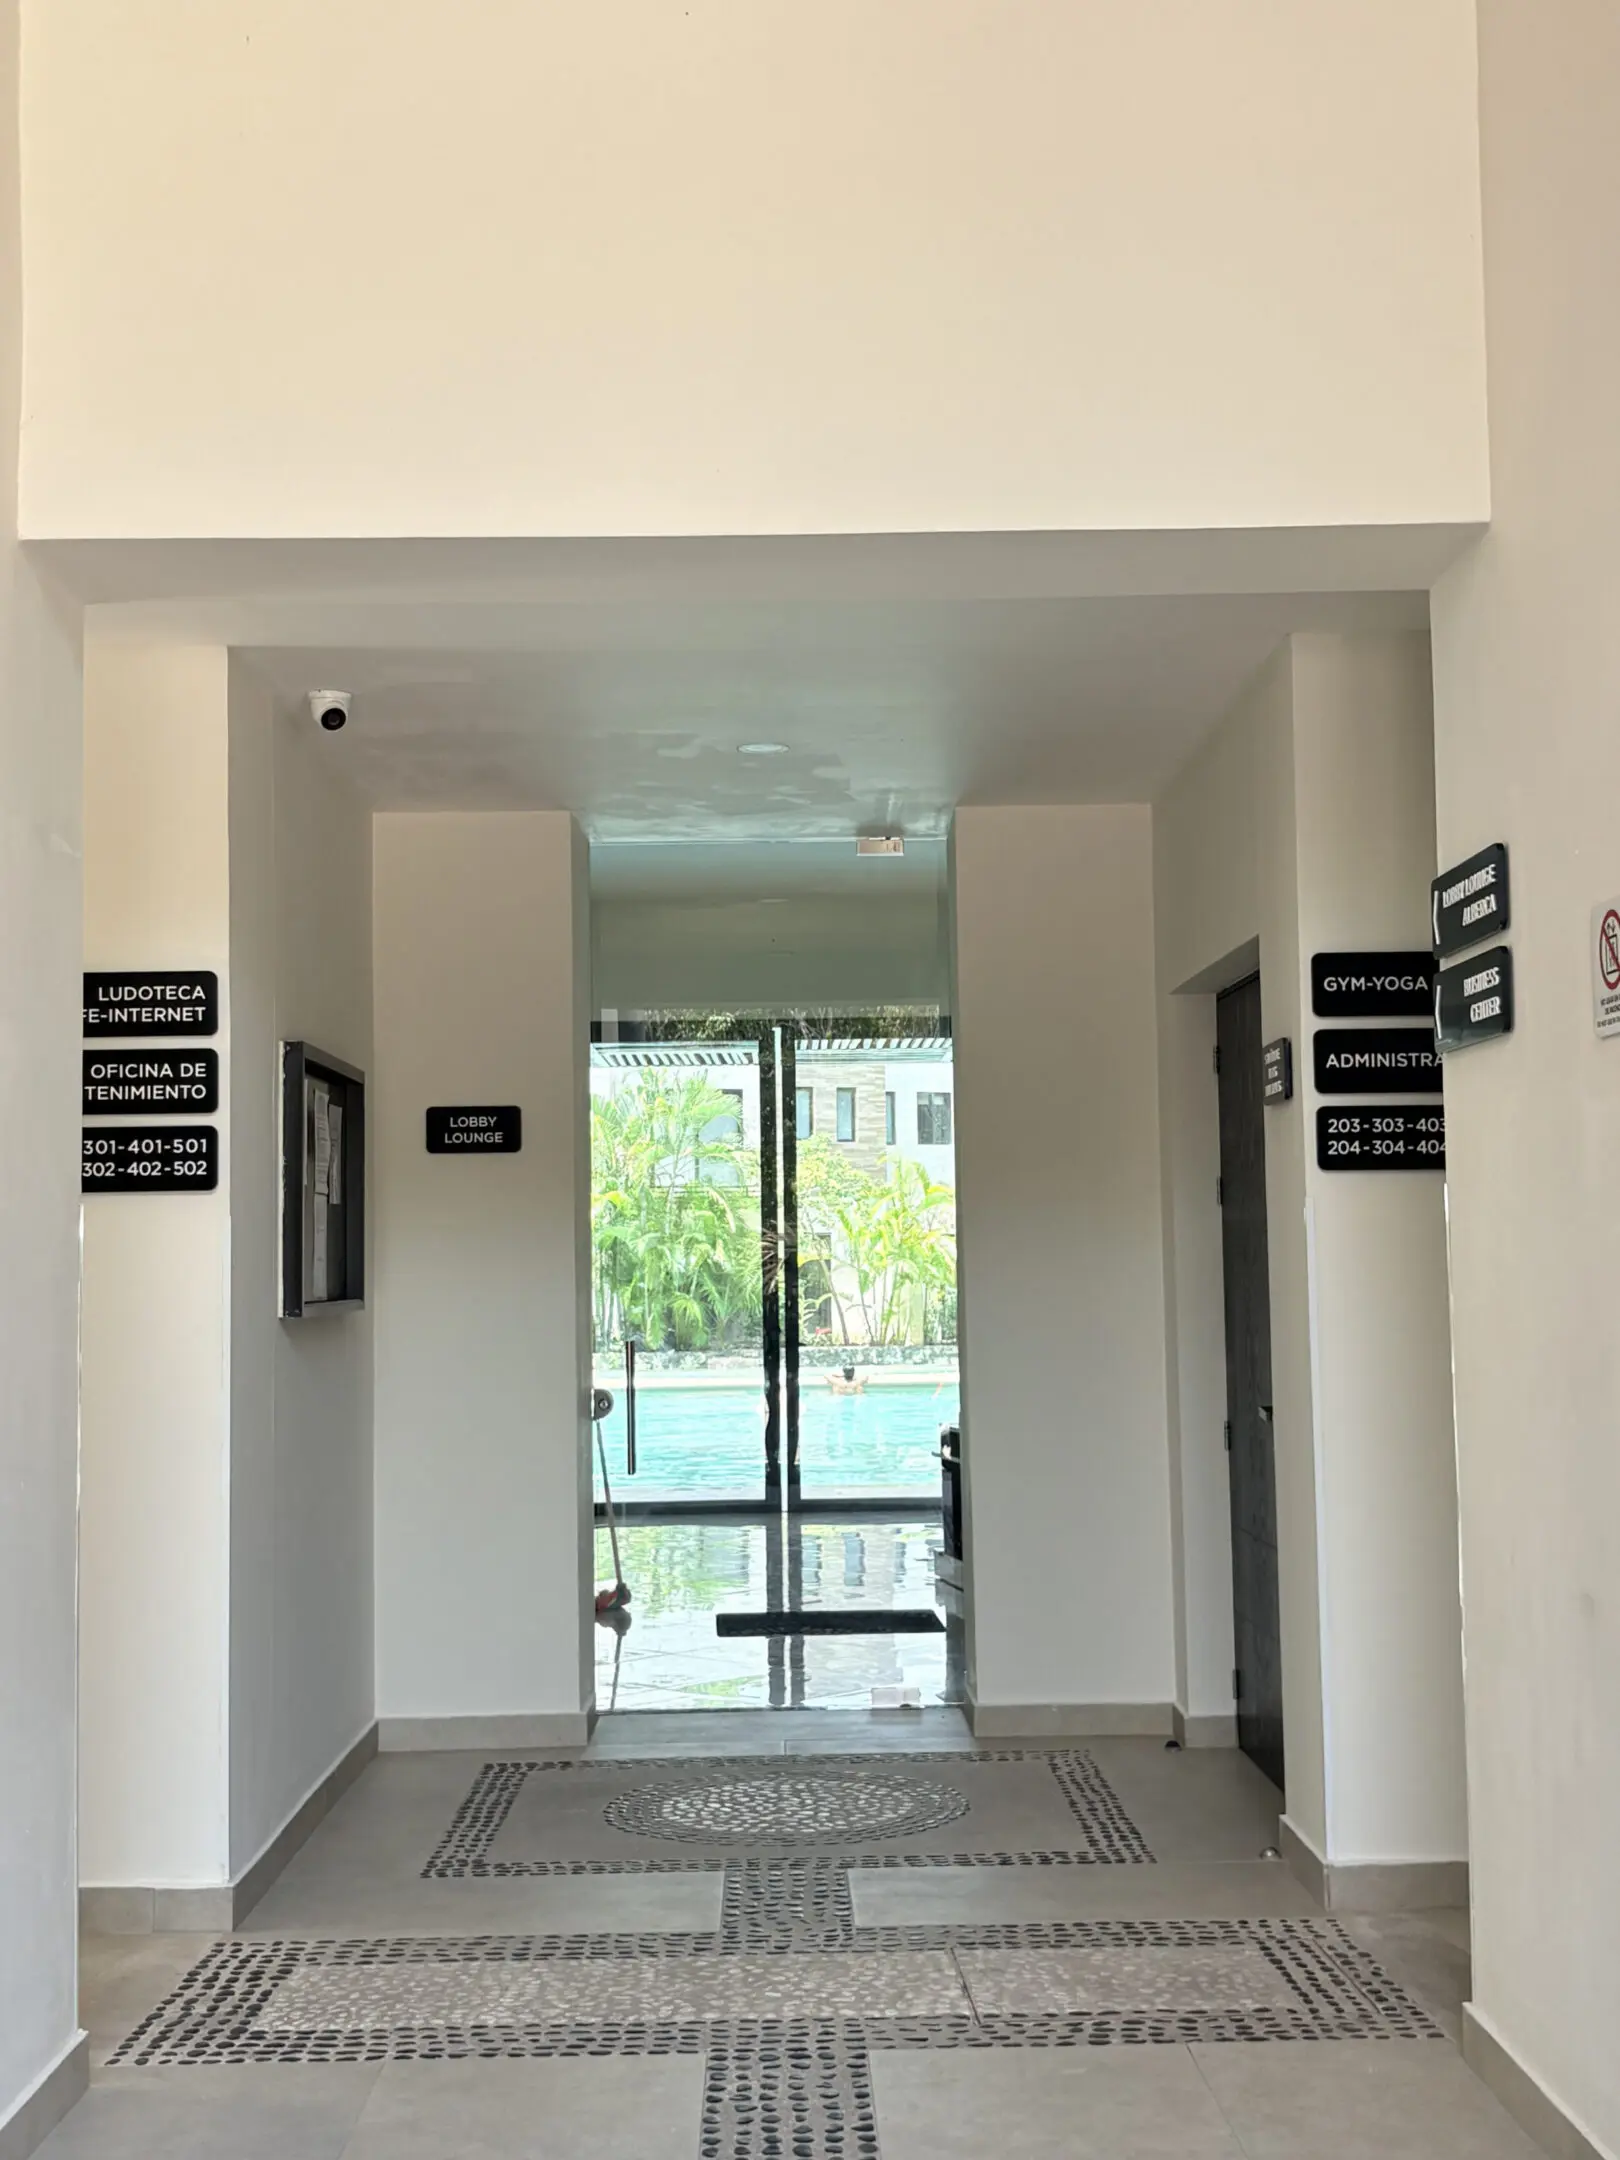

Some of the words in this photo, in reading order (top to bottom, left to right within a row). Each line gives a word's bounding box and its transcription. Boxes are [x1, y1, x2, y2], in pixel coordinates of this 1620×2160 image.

[1323, 975, 1429, 992] GYM-YOGA
[98, 985, 207, 1002] LUDOTECA
[1470, 995, 1501, 1024] CENTER
[90, 1062, 174, 1079] OFICINA
[180, 1062, 207, 1079] DE
[83, 1084, 207, 1101] TENIMIENTO
[449, 1115, 498, 1128] LOBBY
[444, 1131, 504, 1144] LOUNGE
[83, 1138, 207, 1155] 301-401-501
[82, 1160, 207, 1177] 302-402-502
